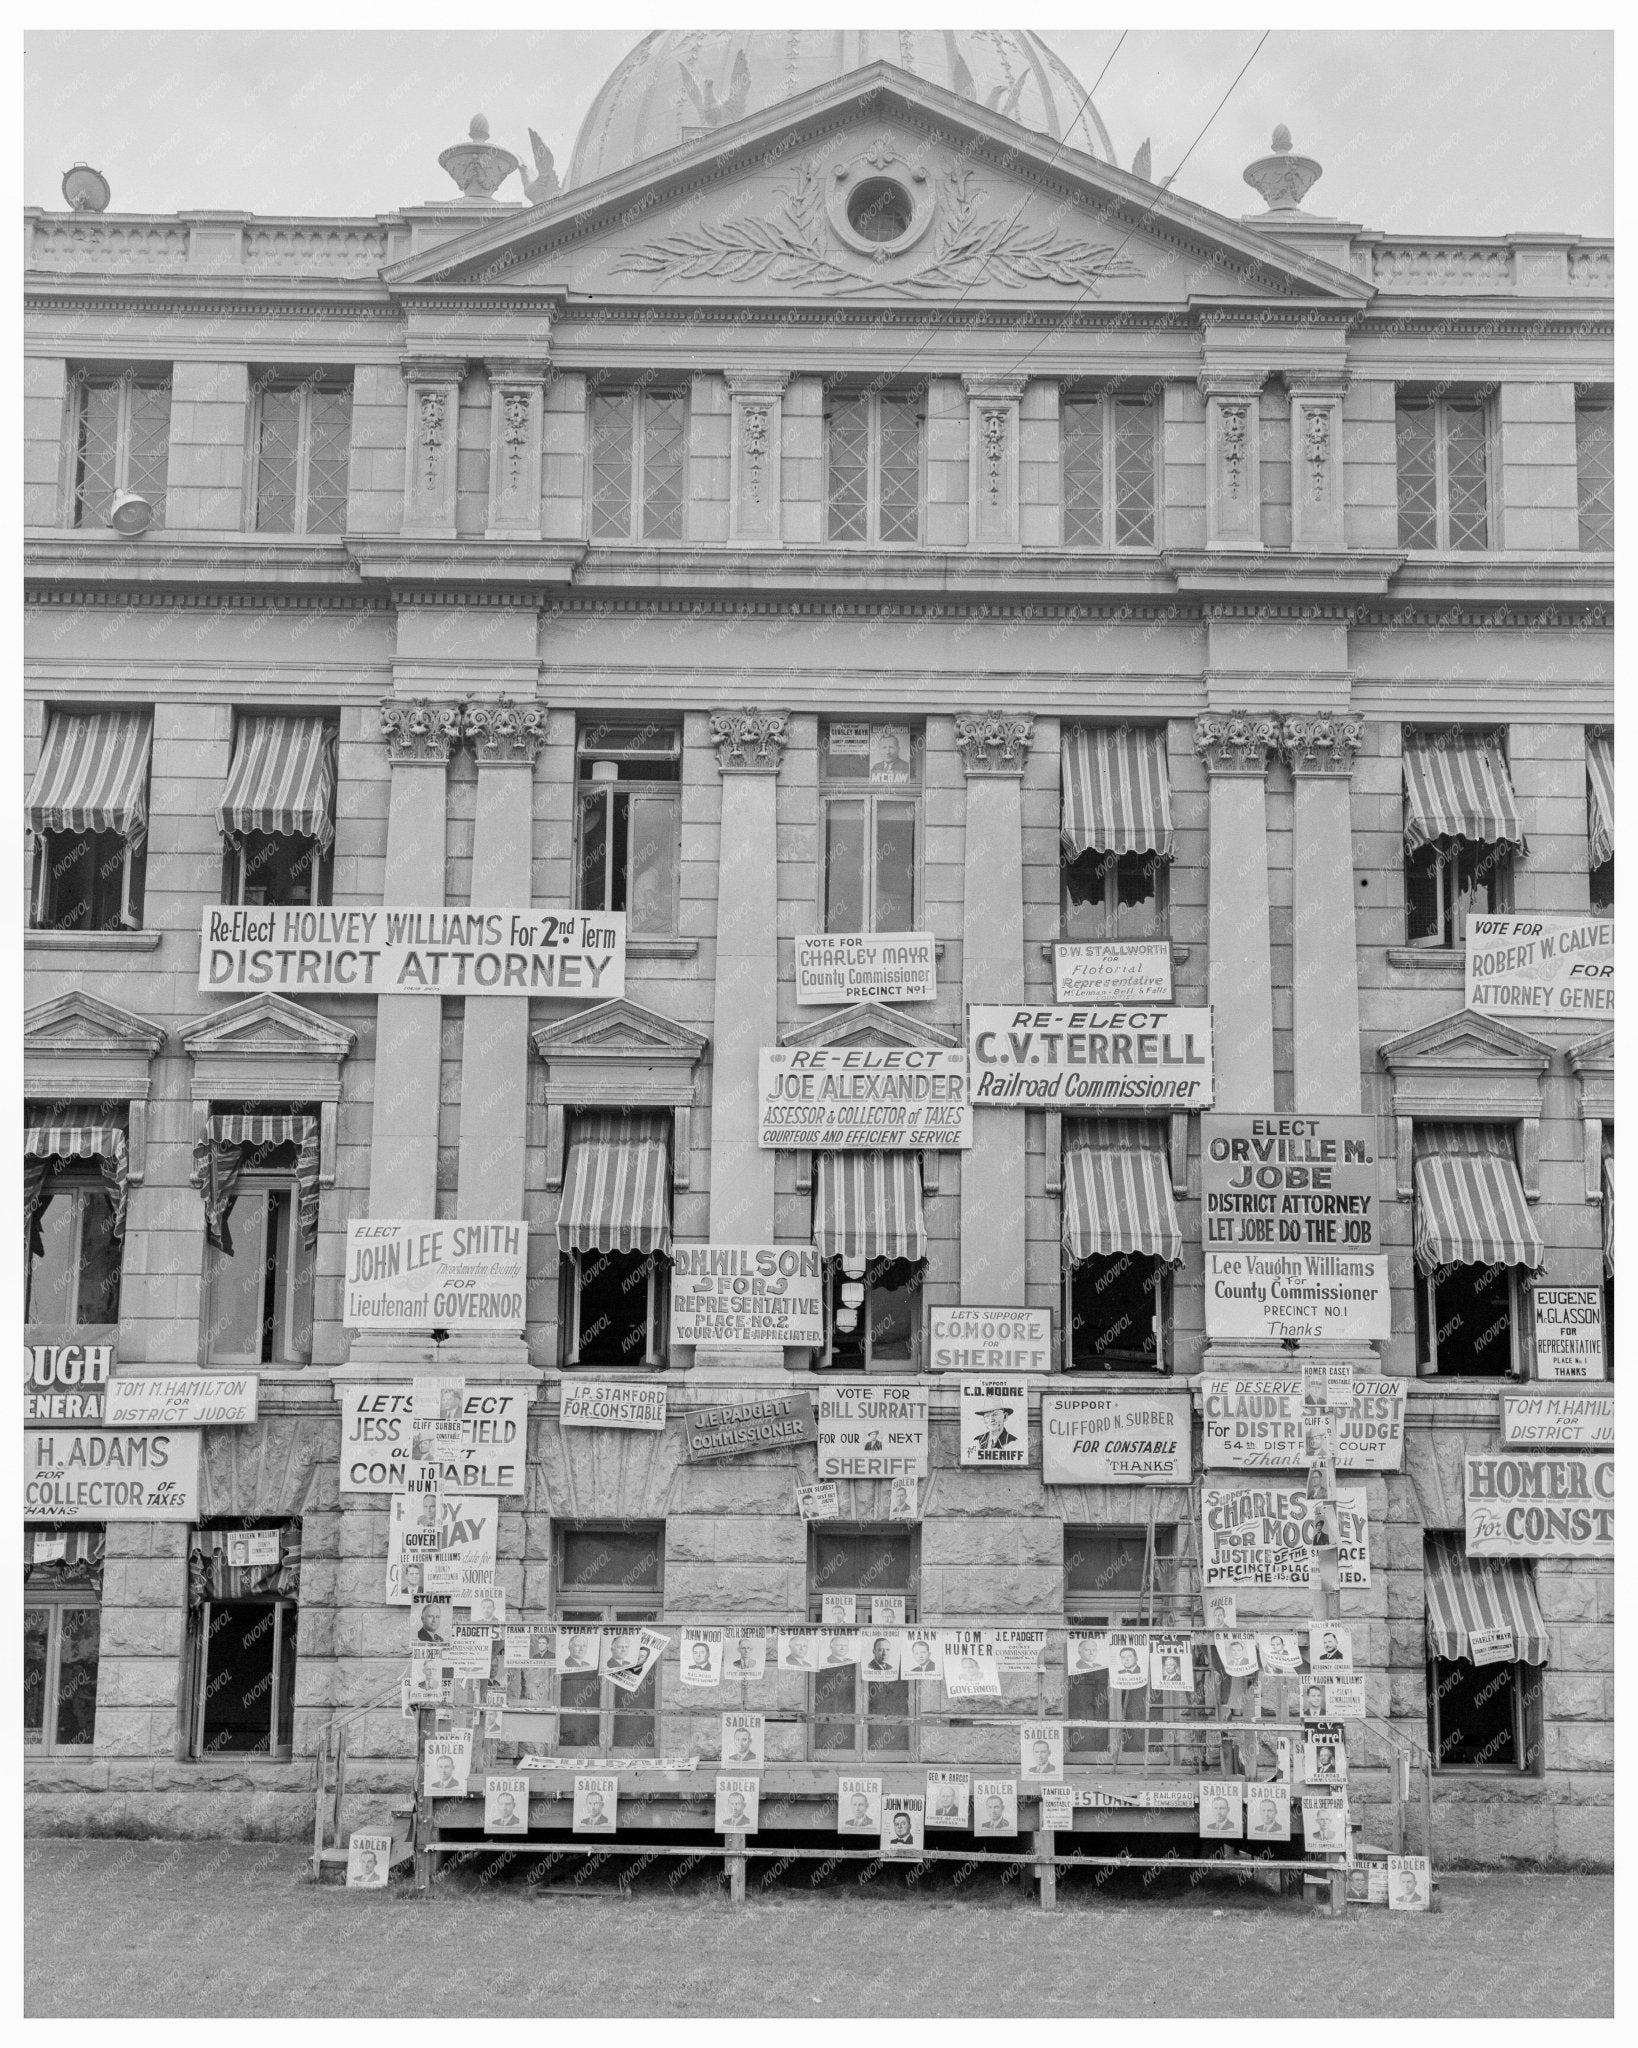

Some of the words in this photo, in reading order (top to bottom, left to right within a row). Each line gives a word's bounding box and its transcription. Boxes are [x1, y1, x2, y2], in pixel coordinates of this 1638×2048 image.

[283, 912, 378, 944] HOLVEY
[386, 913, 502, 946] WILLIAMS
[510, 916, 538, 946] For
[580, 918, 616, 949] Term
[1475, 921, 1510, 935] VOTE
[1513, 922, 1543, 936] FOR
[806, 939, 835, 948] VOTE
[840, 938, 863, 946] FOR
[800, 948, 877, 966] CHARLEY
[882, 946, 929, 964] MAYR
[1086, 944, 1168, 956] STALLWORTH
[1472, 942, 1536, 977] ROBERT
[208, 950, 381, 984] DISTRICT
[396, 951, 614, 988] ATTORNEY
[1072, 962, 1144, 975] Flotorial
[802, 968, 845, 988] County
[849, 966, 930, 985] Commissioner
[1062, 976, 1164, 989] Representative
[846, 986, 902, 996] PRECINCT
[1472, 984, 1554, 1006] ATTORNEY
[1012, 1012, 1168, 1029] RE-ELECT
[791, 1051, 943, 1068] RE-ELECT
[768, 1073, 815, 1100] JOE
[821, 1074, 964, 1100] ALEXANDER
[977, 1071, 1064, 1097] Railroad
[1065, 1072, 1200, 1098] Commissioner
[763, 1106, 826, 1125] ASSESSOR
[838, 1106, 906, 1125] COLLECTOR
[923, 1106, 965, 1125] TAXES
[1252, 1120, 1320, 1136] ELECT
[763, 1130, 820, 1143] COURTEOUS
[821, 1130, 844, 1143] AND
[845, 1130, 906, 1143] EFFICIENT
[909, 1130, 962, 1144] SERVICE
[1209, 1138, 1336, 1162] ORVILLE
[1343, 1140, 1374, 1164] M.
[1228, 1166, 1332, 1189] JOBE
[1208, 1193, 1277, 1213] DISTRICT
[1282, 1195, 1371, 1214] ATTORNEY
[354, 1226, 401, 1238] ELECT
[1208, 1218, 1234, 1241] LET
[1238, 1219, 1274, 1241] JOBE
[1279, 1220, 1300, 1242] DO
[1305, 1220, 1337, 1243] THE
[1342, 1220, 1372, 1243] JOB
[349, 1242, 400, 1284] JOHN
[407, 1231, 444, 1271] LEE
[452, 1225, 520, 1257] SMITH
[1211, 1255, 1242, 1275] Lee
[1246, 1256, 1302, 1281] Vaughn
[1304, 1256, 1375, 1276] Williams
[443, 1280, 476, 1289] FOR
[717, 1277, 767, 1295] FOR
[1214, 1280, 1266, 1302] County
[1271, 1281, 1378, 1300] Commissioner
[674, 1295, 820, 1314] REPRESENTATIVE
[1538, 1292, 1597, 1304] EUGENE
[350, 1292, 429, 1317] Lieutenant
[434, 1292, 522, 1319] GOVERNOR
[1264, 1306, 1318, 1316] PRECINCT
[982, 1311, 1032, 1320] SUPPORT
[1267, 1321, 1323, 1336] Thanks
[1538, 1340, 1601, 1353] REPRESENTATIVE
[936, 1349, 1045, 1367] SHERIFF
[1555, 1368, 1586, 1376] THANKS
[116, 1382, 146, 1396] TOM
[836, 1388, 873, 1399] VOTE
[884, 1389, 910, 1399] FOR
[1211, 1382, 1229, 1392] HE
[166, 1398, 190, 1406] FOR
[596, 1388, 664, 1404] STANFORD
[821, 1401, 853, 1418] BILL
[858, 1402, 927, 1418] SURRATT
[1055, 1401, 1112, 1409] SUPPORT
[1206, 1396, 1291, 1418] CLAUDE
[1505, 1399, 1542, 1414] TOM
[112, 1408, 188, 1421] DISTRICT
[194, 1407, 246, 1421] JUDGE
[593, 1402, 662, 1422] CONSTABLE
[350, 1417, 401, 1442] JESS
[1050, 1417, 1110, 1436] CLIFFORD
[1126, 1411, 1174, 1427] SURBER
[1207, 1421, 1230, 1438] For
[1340, 1423, 1400, 1439] JUDGE
[692, 1420, 803, 1450] COMMISSIONER
[820, 1434, 836, 1444] FOR
[841, 1434, 860, 1444] OUR
[888, 1433, 923, 1443] NEXT
[1511, 1426, 1584, 1439] DISTRICT
[68, 1436, 170, 1467] ADAMS
[1073, 1440, 1100, 1453] FOR
[1104, 1441, 1177, 1454] CONSTABLE
[1339, 1442, 1386, 1450] COURT
[978, 1450, 1024, 1460] SHERIFF
[825, 1458, 916, 1475] SHERIFF
[35, 1471, 64, 1479] FOR
[1468, 1461, 1593, 1498] HOMER
[26, 1482, 144, 1506] COLLECTOR
[157, 1482, 176, 1491] OF
[146, 1494, 186, 1506] TAXES
[1208, 1492, 1308, 1530] CHARLES
[1211, 1549, 1272, 1564] JUSTICE
[1289, 1548, 1307, 1558] THE
[1255, 1573, 1271, 1582] HE
[413, 1595, 451, 1604] STUART
[474, 1590, 502, 1598] SADLER
[825, 1597, 853, 1606] SADLER
[874, 1599, 902, 1608] SADLER
[456, 1627, 489, 1637] PADGETT
[603, 1627, 641, 1636] STUART
[703, 1630, 721, 1642] WOOD
[780, 1628, 818, 1636] STUART
[820, 1628, 859, 1636] STUART
[908, 1631, 936, 1640] MANN
[955, 1631, 981, 1643] TOM
[1069, 1631, 1107, 1639] STUART
[1232, 1632, 1255, 1640] WILSON
[1109, 1633, 1127, 1646] JOHN
[1129, 1634, 1147, 1646] WOOD
[945, 1644, 992, 1656] HUNTER
[1151, 1640, 1191, 1653] Terrell
[1335, 1676, 1363, 1684] WILLIAMS
[726, 1716, 761, 1728] SADLER
[1024, 1730, 1059, 1739] SADLER
[428, 1744, 464, 1755] SADLER
[490, 1781, 525, 1792] SADLER
[578, 1780, 614, 1792] SADLER
[719, 1781, 755, 1792] SADLER
[842, 1781, 878, 1793] SADLER
[978, 1784, 1013, 1794] SADLER
[1203, 1786, 1238, 1796] SADLER
[1154, 1792, 1192, 1800] RAILROAD
[1251, 1788, 1286, 1798] SADLER
[884, 1798, 902, 1811] JOHN
[904, 1799, 922, 1812] WOOD
[352, 1839, 387, 1850] SADLER
[1392, 1860, 1425, 1870] SADLER
